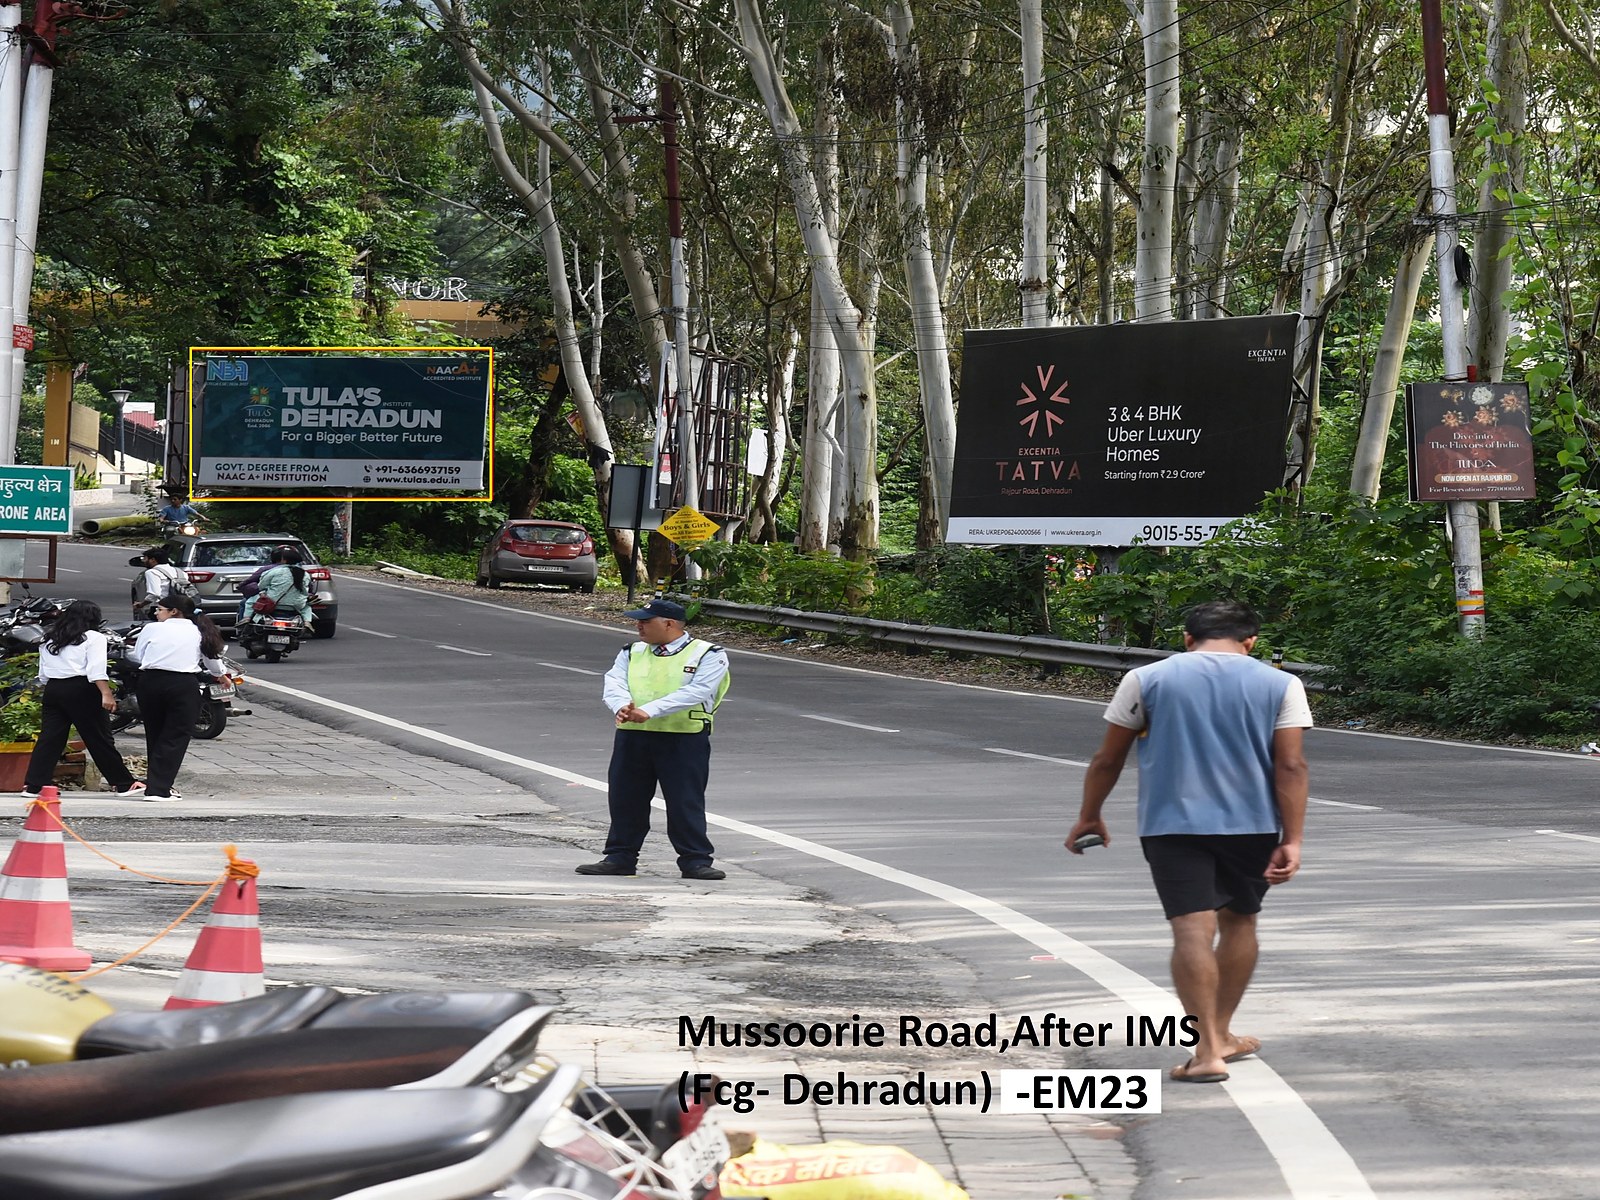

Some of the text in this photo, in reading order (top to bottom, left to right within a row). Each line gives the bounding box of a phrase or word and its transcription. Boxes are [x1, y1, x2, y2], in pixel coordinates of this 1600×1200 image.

[1248, 349, 1287, 357] EXCENTIA
[206, 360, 249, 381] NBA
[282, 387, 382, 407] TULA'S
[281, 409, 442, 429] DEHRADUN
[1108, 405, 1183, 422] 3 & 4 BHK
[281, 431, 443, 444] For a Bigger Better Future
[1107, 426, 1202, 446] Uber Luxury
[1453, 432, 1494, 440] Dive into
[1429, 441, 1447, 449] The
[1449, 441, 1484, 449] Flavors
[1485, 441, 1496, 449] of
[1018, 447, 1060, 456] EXCENTIA
[1106, 446, 1160, 462] Homes
[215, 463, 330, 473] GOVT. DEGREE FROM A
[375, 464, 461, 475] +91-6366937159
[996, 460, 1081, 481] TATVA
[217, 472, 327, 482] NAAC A+ INSTITUTION
[376, 475, 460, 484] www.tulas.edu.in
[1104, 470, 1137, 482] Starting
[1138, 470, 1159, 480] from
[37, 474, 62, 493] क्षेत्र
[1022, 487, 1040, 495] Road,
[1041, 487, 1073, 495] Dehradun
[34, 506, 66, 521] AREA
[1051, 529, 1102, 537] www.ukrera.org.in
